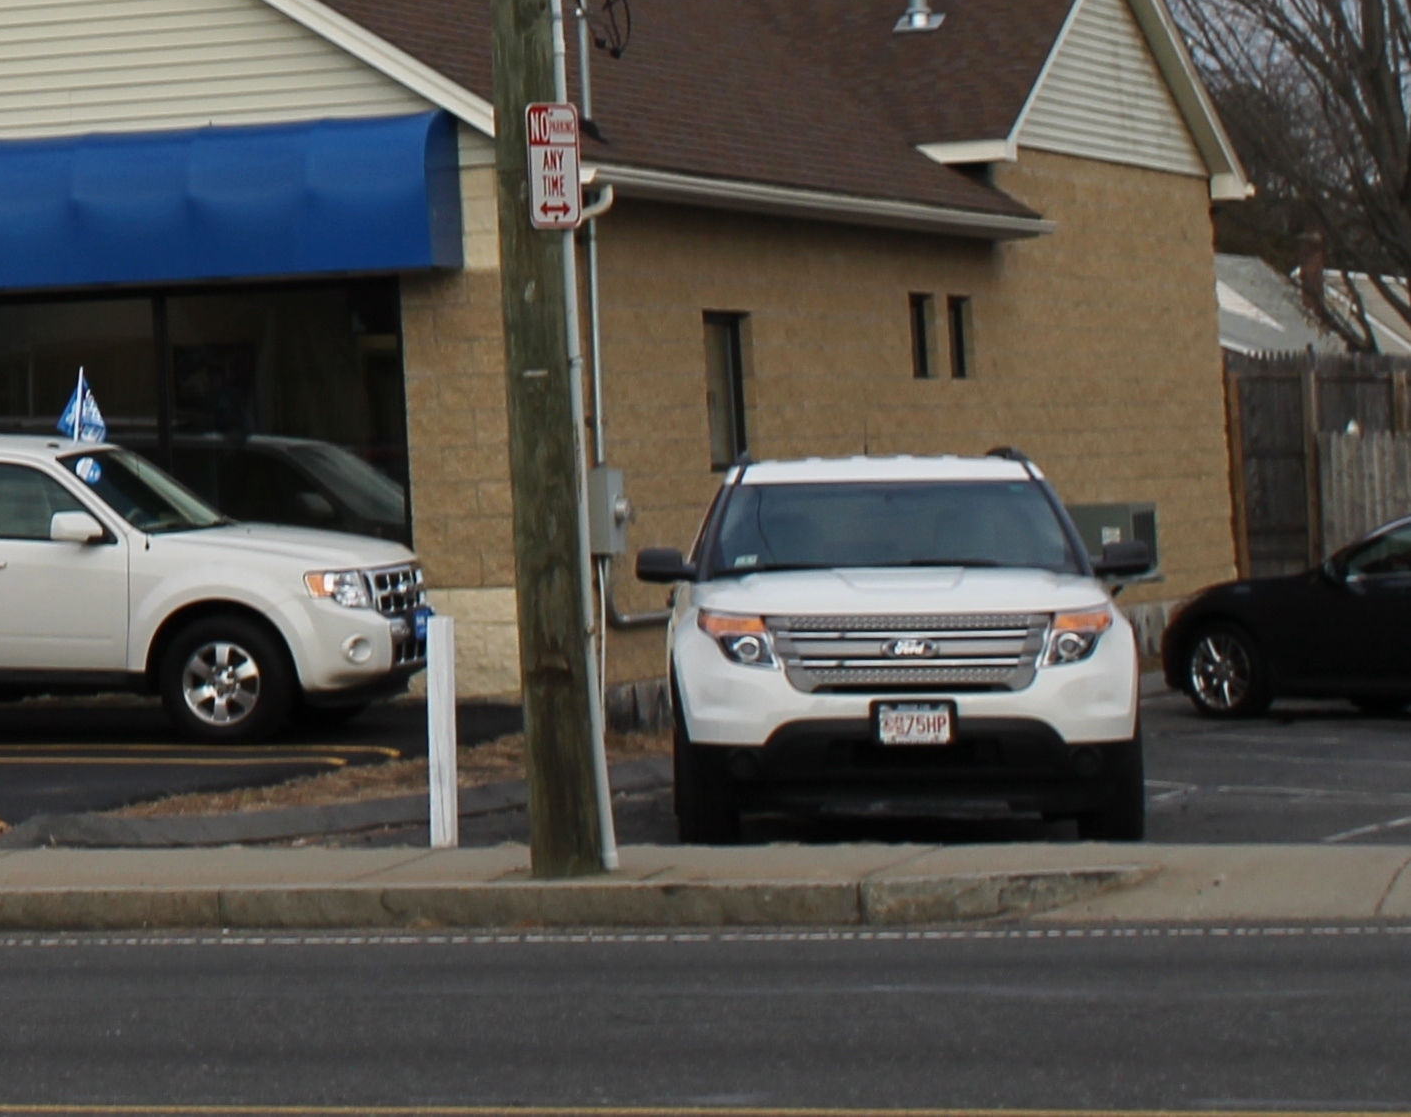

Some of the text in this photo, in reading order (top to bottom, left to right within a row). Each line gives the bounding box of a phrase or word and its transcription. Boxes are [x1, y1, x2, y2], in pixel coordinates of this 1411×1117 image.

[530, 111, 549, 142] NO
[543, 149, 564, 172] ANY
[543, 174, 565, 197] TIME
